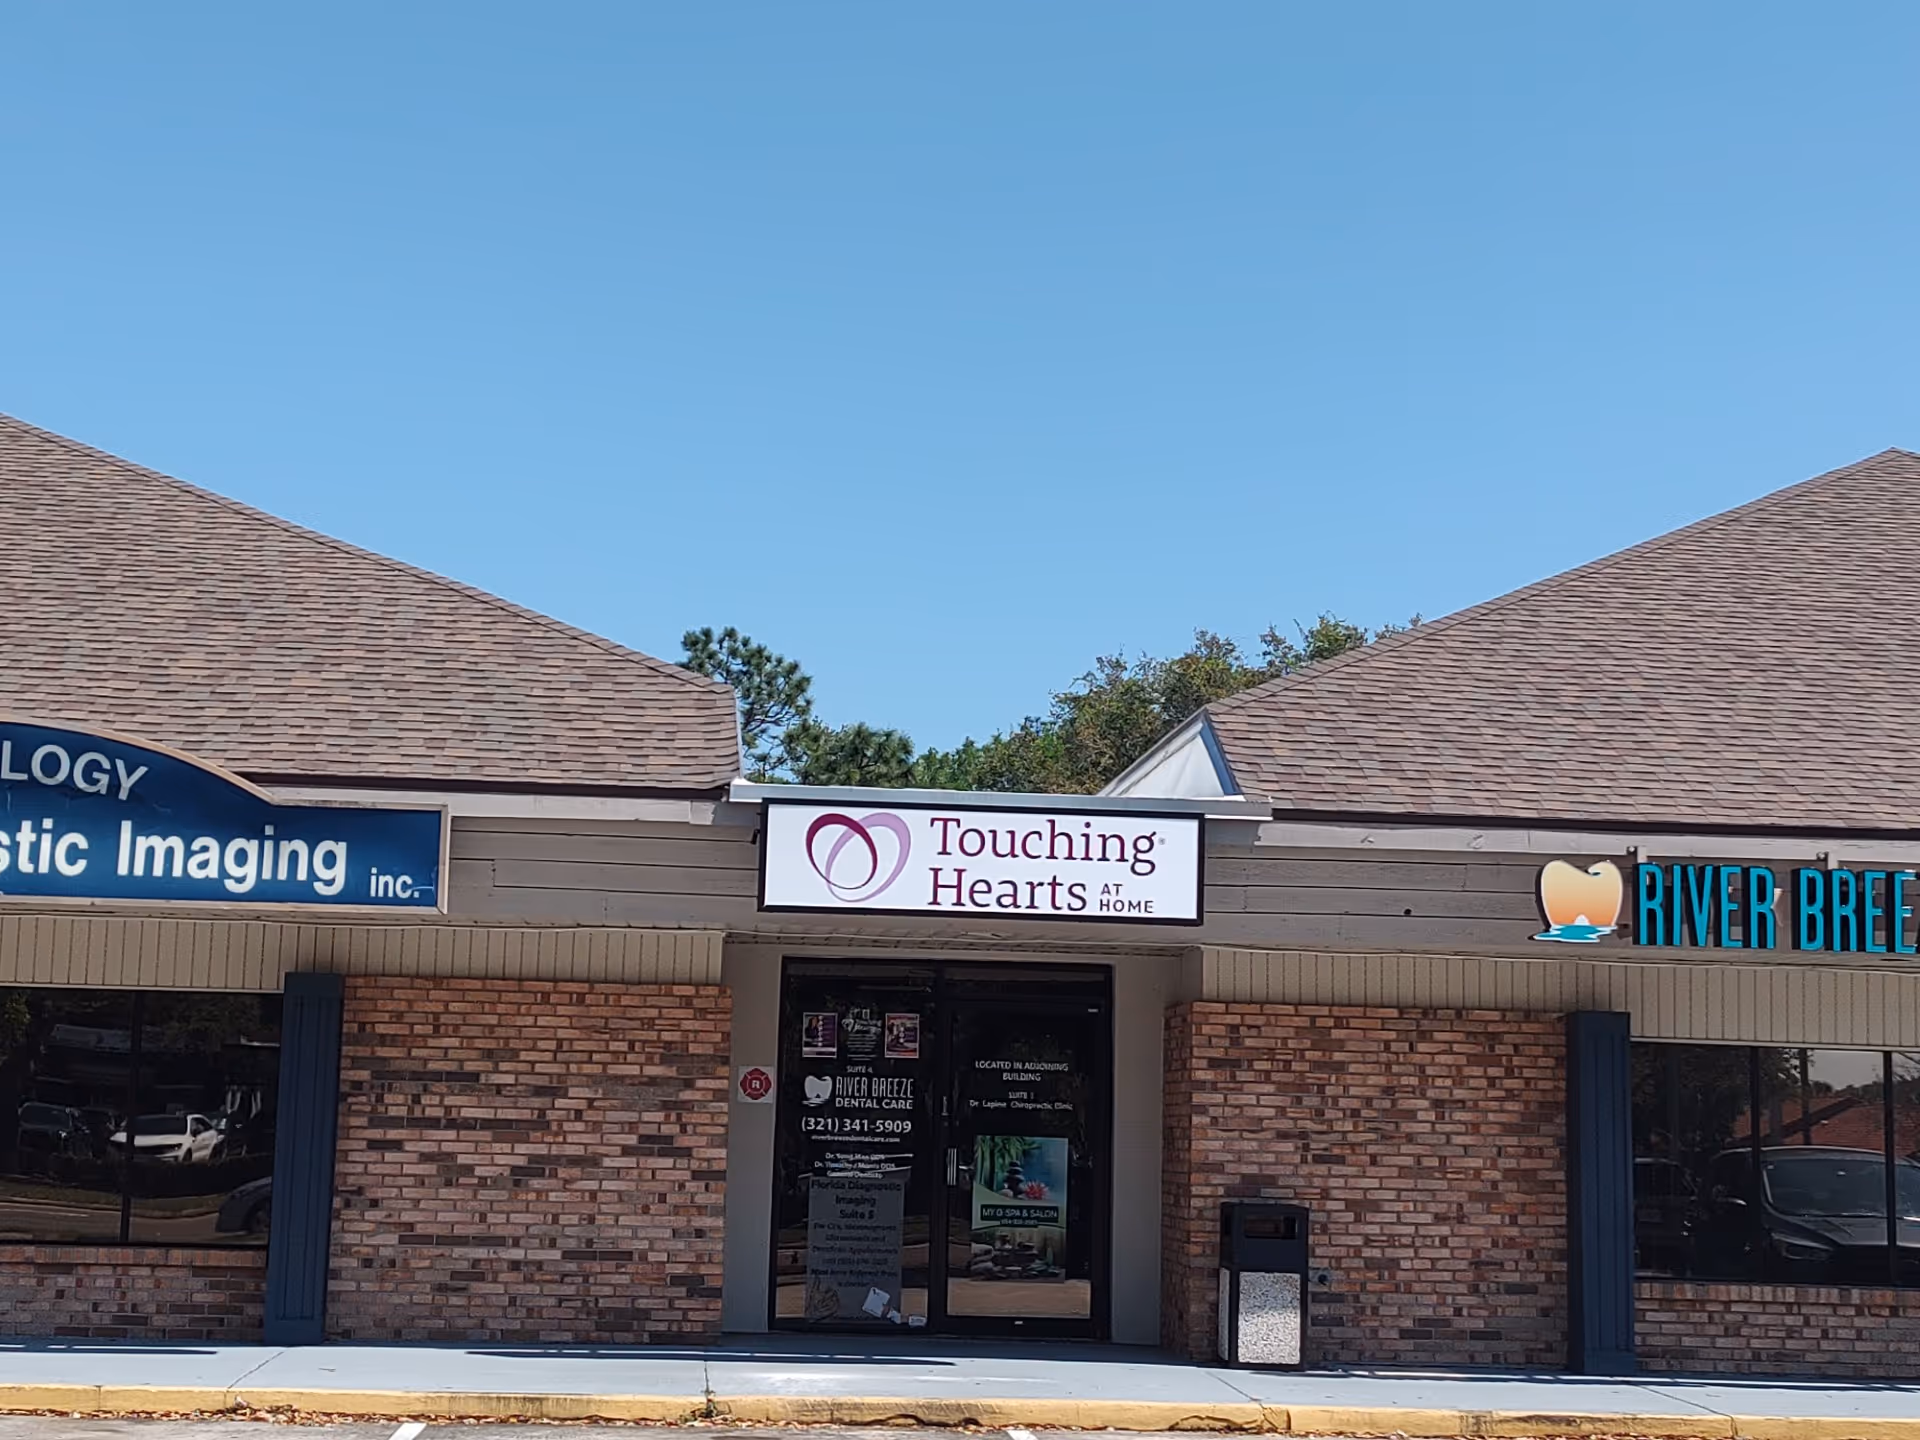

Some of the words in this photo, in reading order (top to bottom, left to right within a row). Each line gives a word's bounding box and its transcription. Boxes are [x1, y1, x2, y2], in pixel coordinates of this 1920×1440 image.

[1, 740, 149, 800] LOGY
[931, 817, 1157, 876] Touching
[117, 820, 348, 895] Imaging
[370, 868, 420, 898] inc.
[927, 868, 1087, 912] Hearts
[1100, 883, 1124, 897] AT
[1099, 899, 1155, 914] HOME
[1634, 862, 1776, 950] RIVER
[1793, 867, 1920, 954] BREE
[846, 1065, 866, 1073] SUITE
[975, 1060, 1011, 1069] LOCATED
[1013, 1061, 1023, 1070] IN
[1024, 1062, 1069, 1072] ADJOINING
[1002, 1072, 1042, 1082] BUILDING
[751, 1080, 760, 1089] R
[836, 1076, 868, 1097] RIVER
[872, 1077, 915, 1099] BREEZE
[835, 1098, 880, 1109] DENTAL
[882, 1099, 914, 1110] CARE
[1010, 1101, 1054, 1110] Chiropractic
[1054, 1102, 1073, 1111] Clinic
[801, 1116, 839, 1133] (321)
[842, 1118, 912, 1134] 341-5909
[811, 1179, 846, 1189] Florida
[848, 1180, 902, 1192] Diagnostic
[835, 1195, 877, 1207] Imaging
[839, 1209, 865, 1219] Suite
[1004, 1208, 1021, 1217] SPA
[1022, 1208, 1028, 1217] &
[1030, 1209, 1058, 1218] SALON
